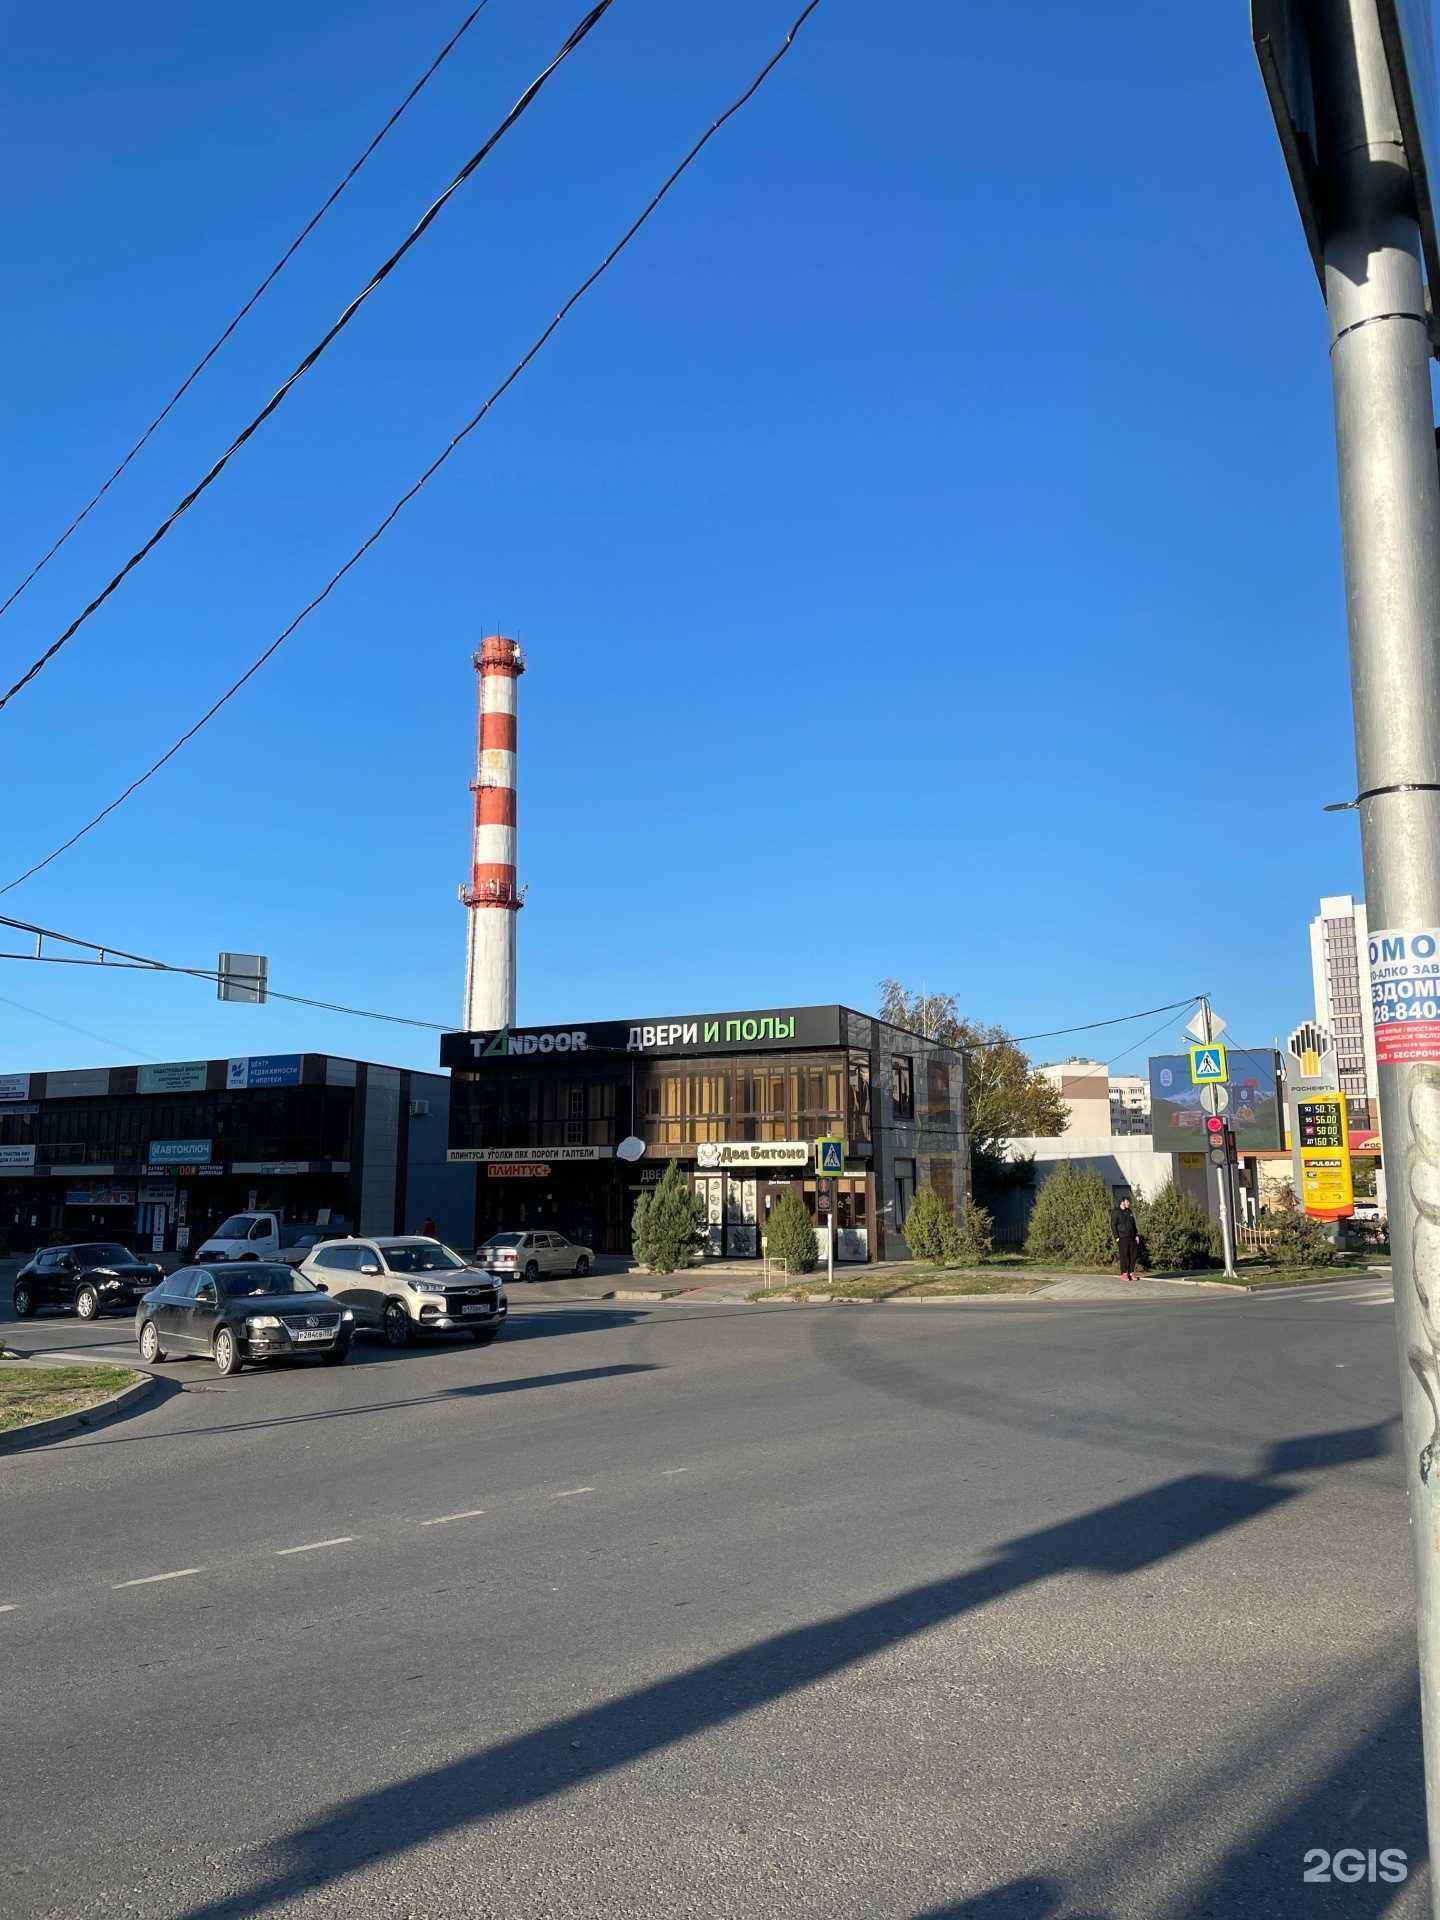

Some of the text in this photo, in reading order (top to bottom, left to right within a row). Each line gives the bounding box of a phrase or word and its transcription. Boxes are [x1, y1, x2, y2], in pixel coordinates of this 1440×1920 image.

[626, 1016, 796, 1052] ДВЕРИ И ПОЛЫ
[450, 1151, 485, 1160] ПЛИНТУСА
[487, 1151, 513, 1160] УГОЛКИ
[531, 1150, 559, 1159] ПОРОГИ
[561, 1149, 594, 1158] ГАЛТЕЛИ
[720, 1146, 750, 1163] Два
